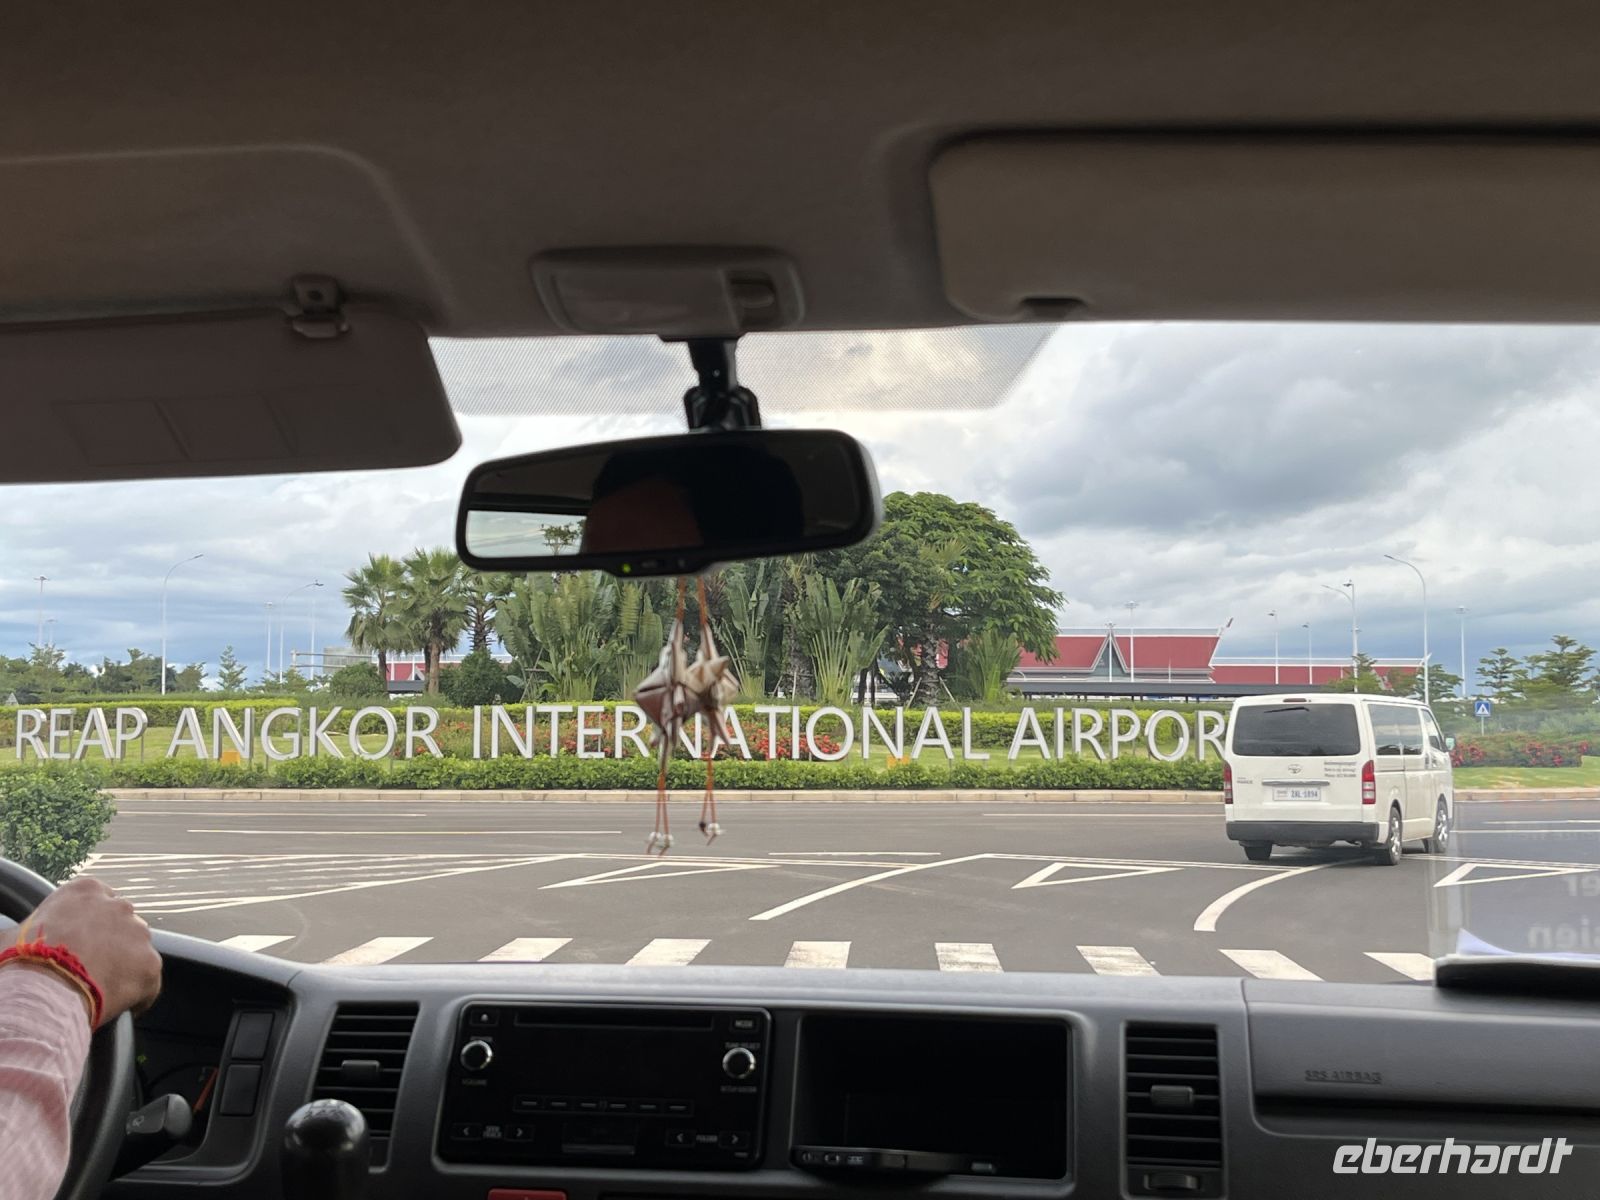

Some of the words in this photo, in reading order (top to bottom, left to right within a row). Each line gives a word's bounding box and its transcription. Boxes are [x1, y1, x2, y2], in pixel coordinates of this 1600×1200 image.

[15, 707, 149, 761] REAP
[166, 706, 444, 760] ANGKOR
[1007, 706, 1228, 761] AIRPOR
[1304, 1070, 1328, 1081] SRS
[1331, 1071, 1383, 1083] AIRBAG
